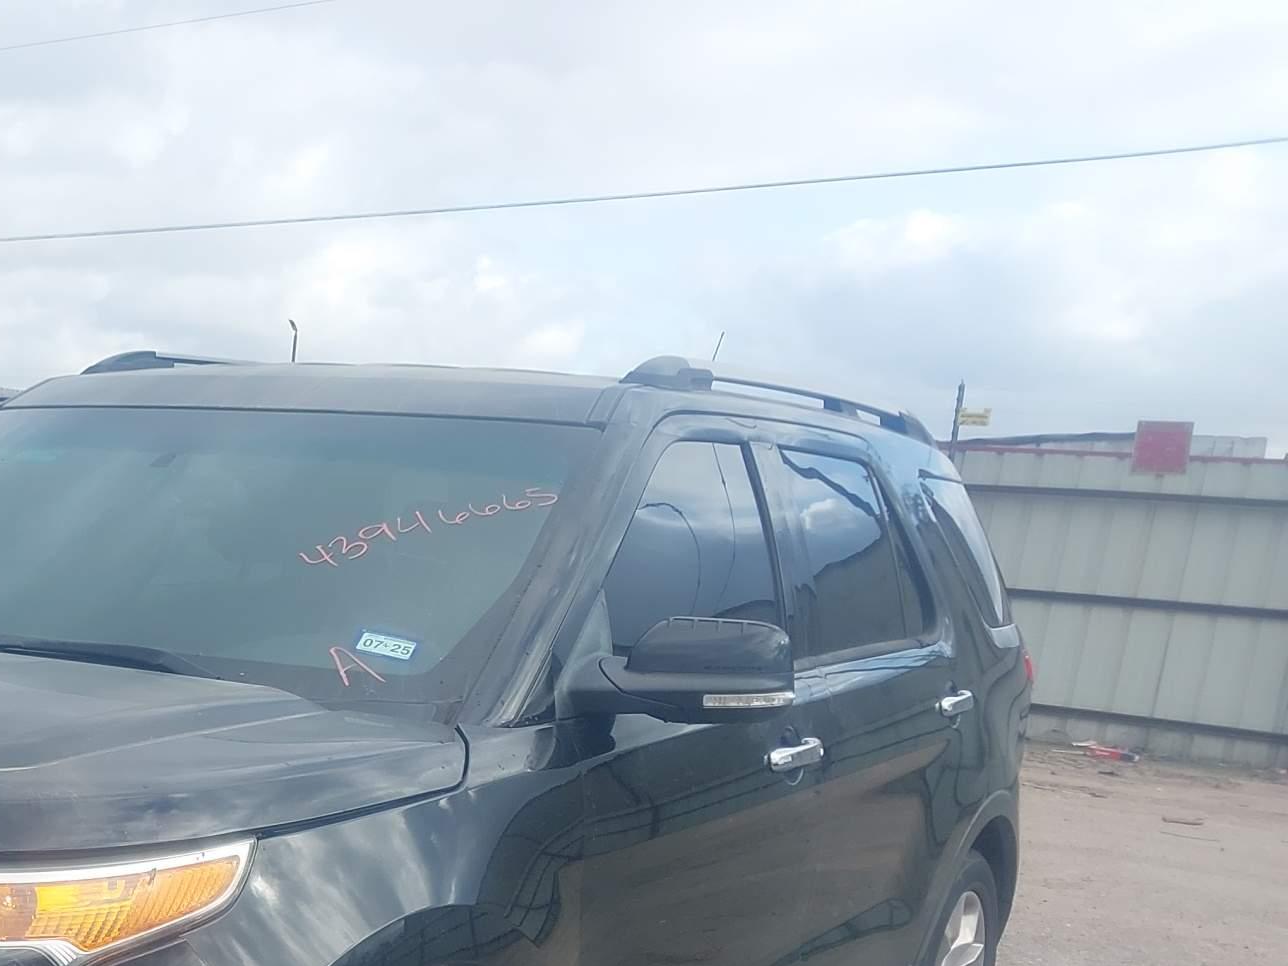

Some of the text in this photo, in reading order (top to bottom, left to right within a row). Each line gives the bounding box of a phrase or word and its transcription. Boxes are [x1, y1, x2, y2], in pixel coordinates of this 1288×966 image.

[299, 487, 559, 567] 43946665
[328, 646, 386, 687] A
[363, 638, 412, 656] 07 25
